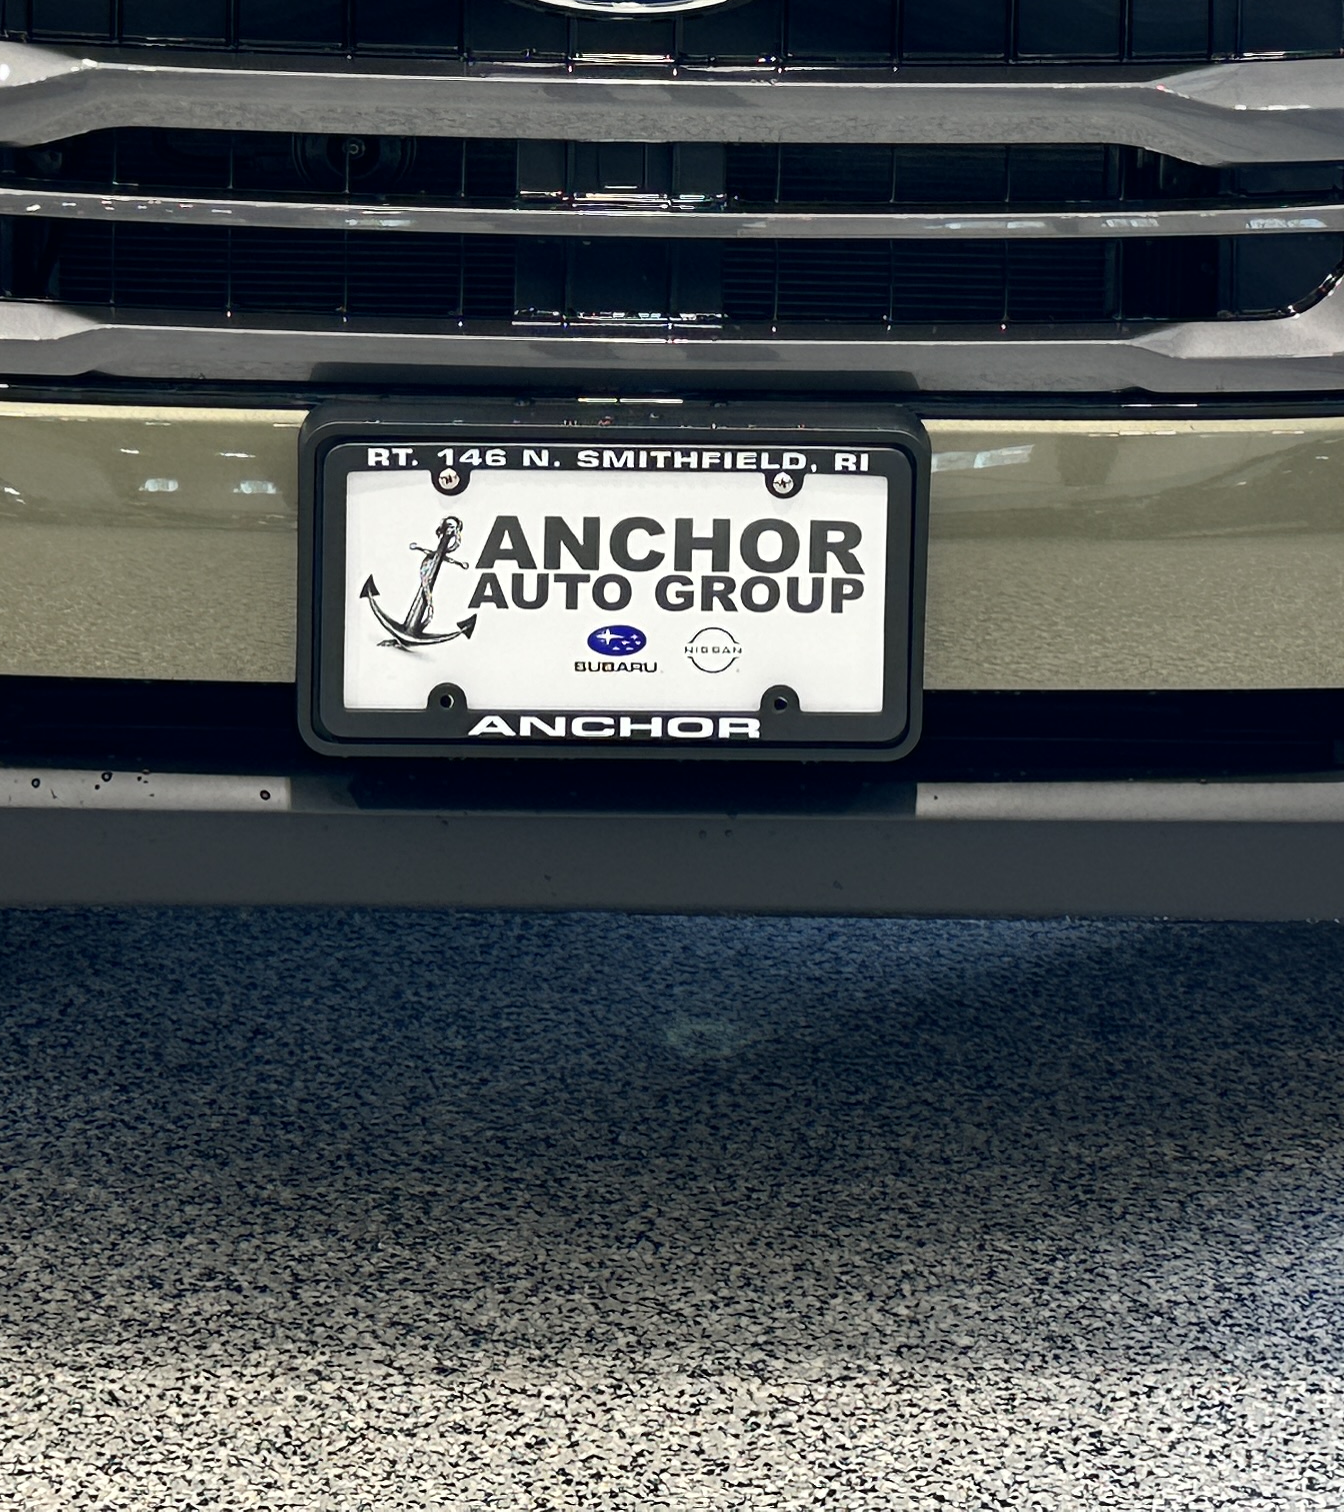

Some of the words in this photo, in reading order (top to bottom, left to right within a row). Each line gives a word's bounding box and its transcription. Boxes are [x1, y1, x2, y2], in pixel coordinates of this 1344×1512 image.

[367, 447, 420, 467] RT.
[437, 448, 507, 467] 146
[522, 448, 562, 468] N.
[577, 449, 818, 474] SMITHFIELD,
[835, 452, 870, 473] RI
[475, 515, 866, 575] ANCHOR
[467, 574, 633, 611] AUTO
[655, 576, 866, 614] GROUP
[684, 645, 743, 655] NISSAN
[574, 661, 658, 674] SUBARU
[467, 715, 762, 740] ANCHOR
